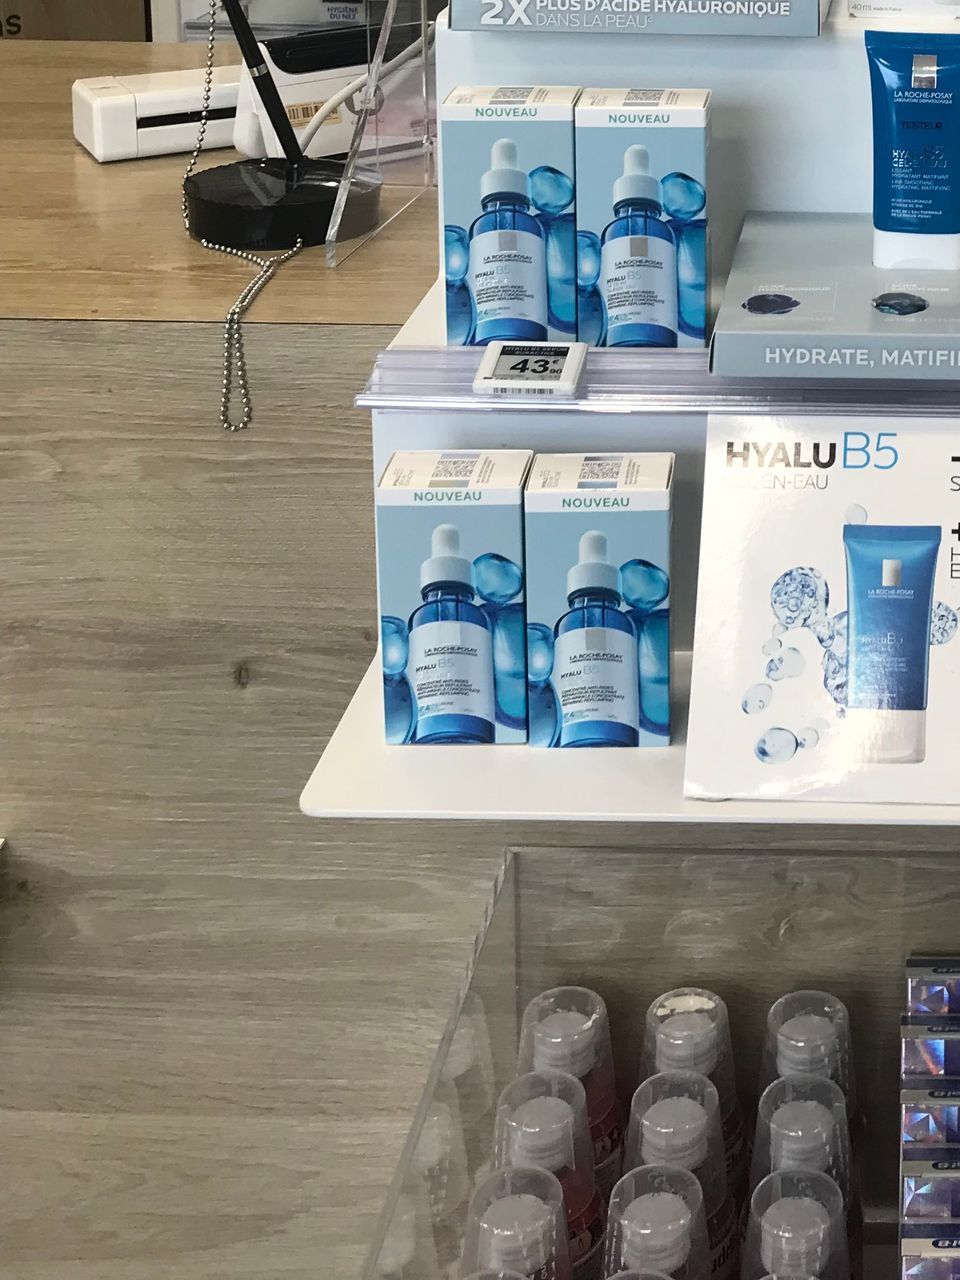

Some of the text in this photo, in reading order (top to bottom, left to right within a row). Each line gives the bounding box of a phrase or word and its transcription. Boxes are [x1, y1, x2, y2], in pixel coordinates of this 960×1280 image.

[654, 0, 790, 19] HYALURONIQUE
[536, 13, 582, 27] DANS
[583, 14, 602, 27] LA
[475, 107, 538, 118] NOUVEAU
[608, 113, 671, 124] NOUVEAU
[765, 348, 876, 369] HYDRATE,
[726, 441, 837, 469] HYALU
[842, 431, 899, 470] B5
[413, 491, 482, 502] NOUVEAU
[561, 497, 630, 508] NOUVEAU
